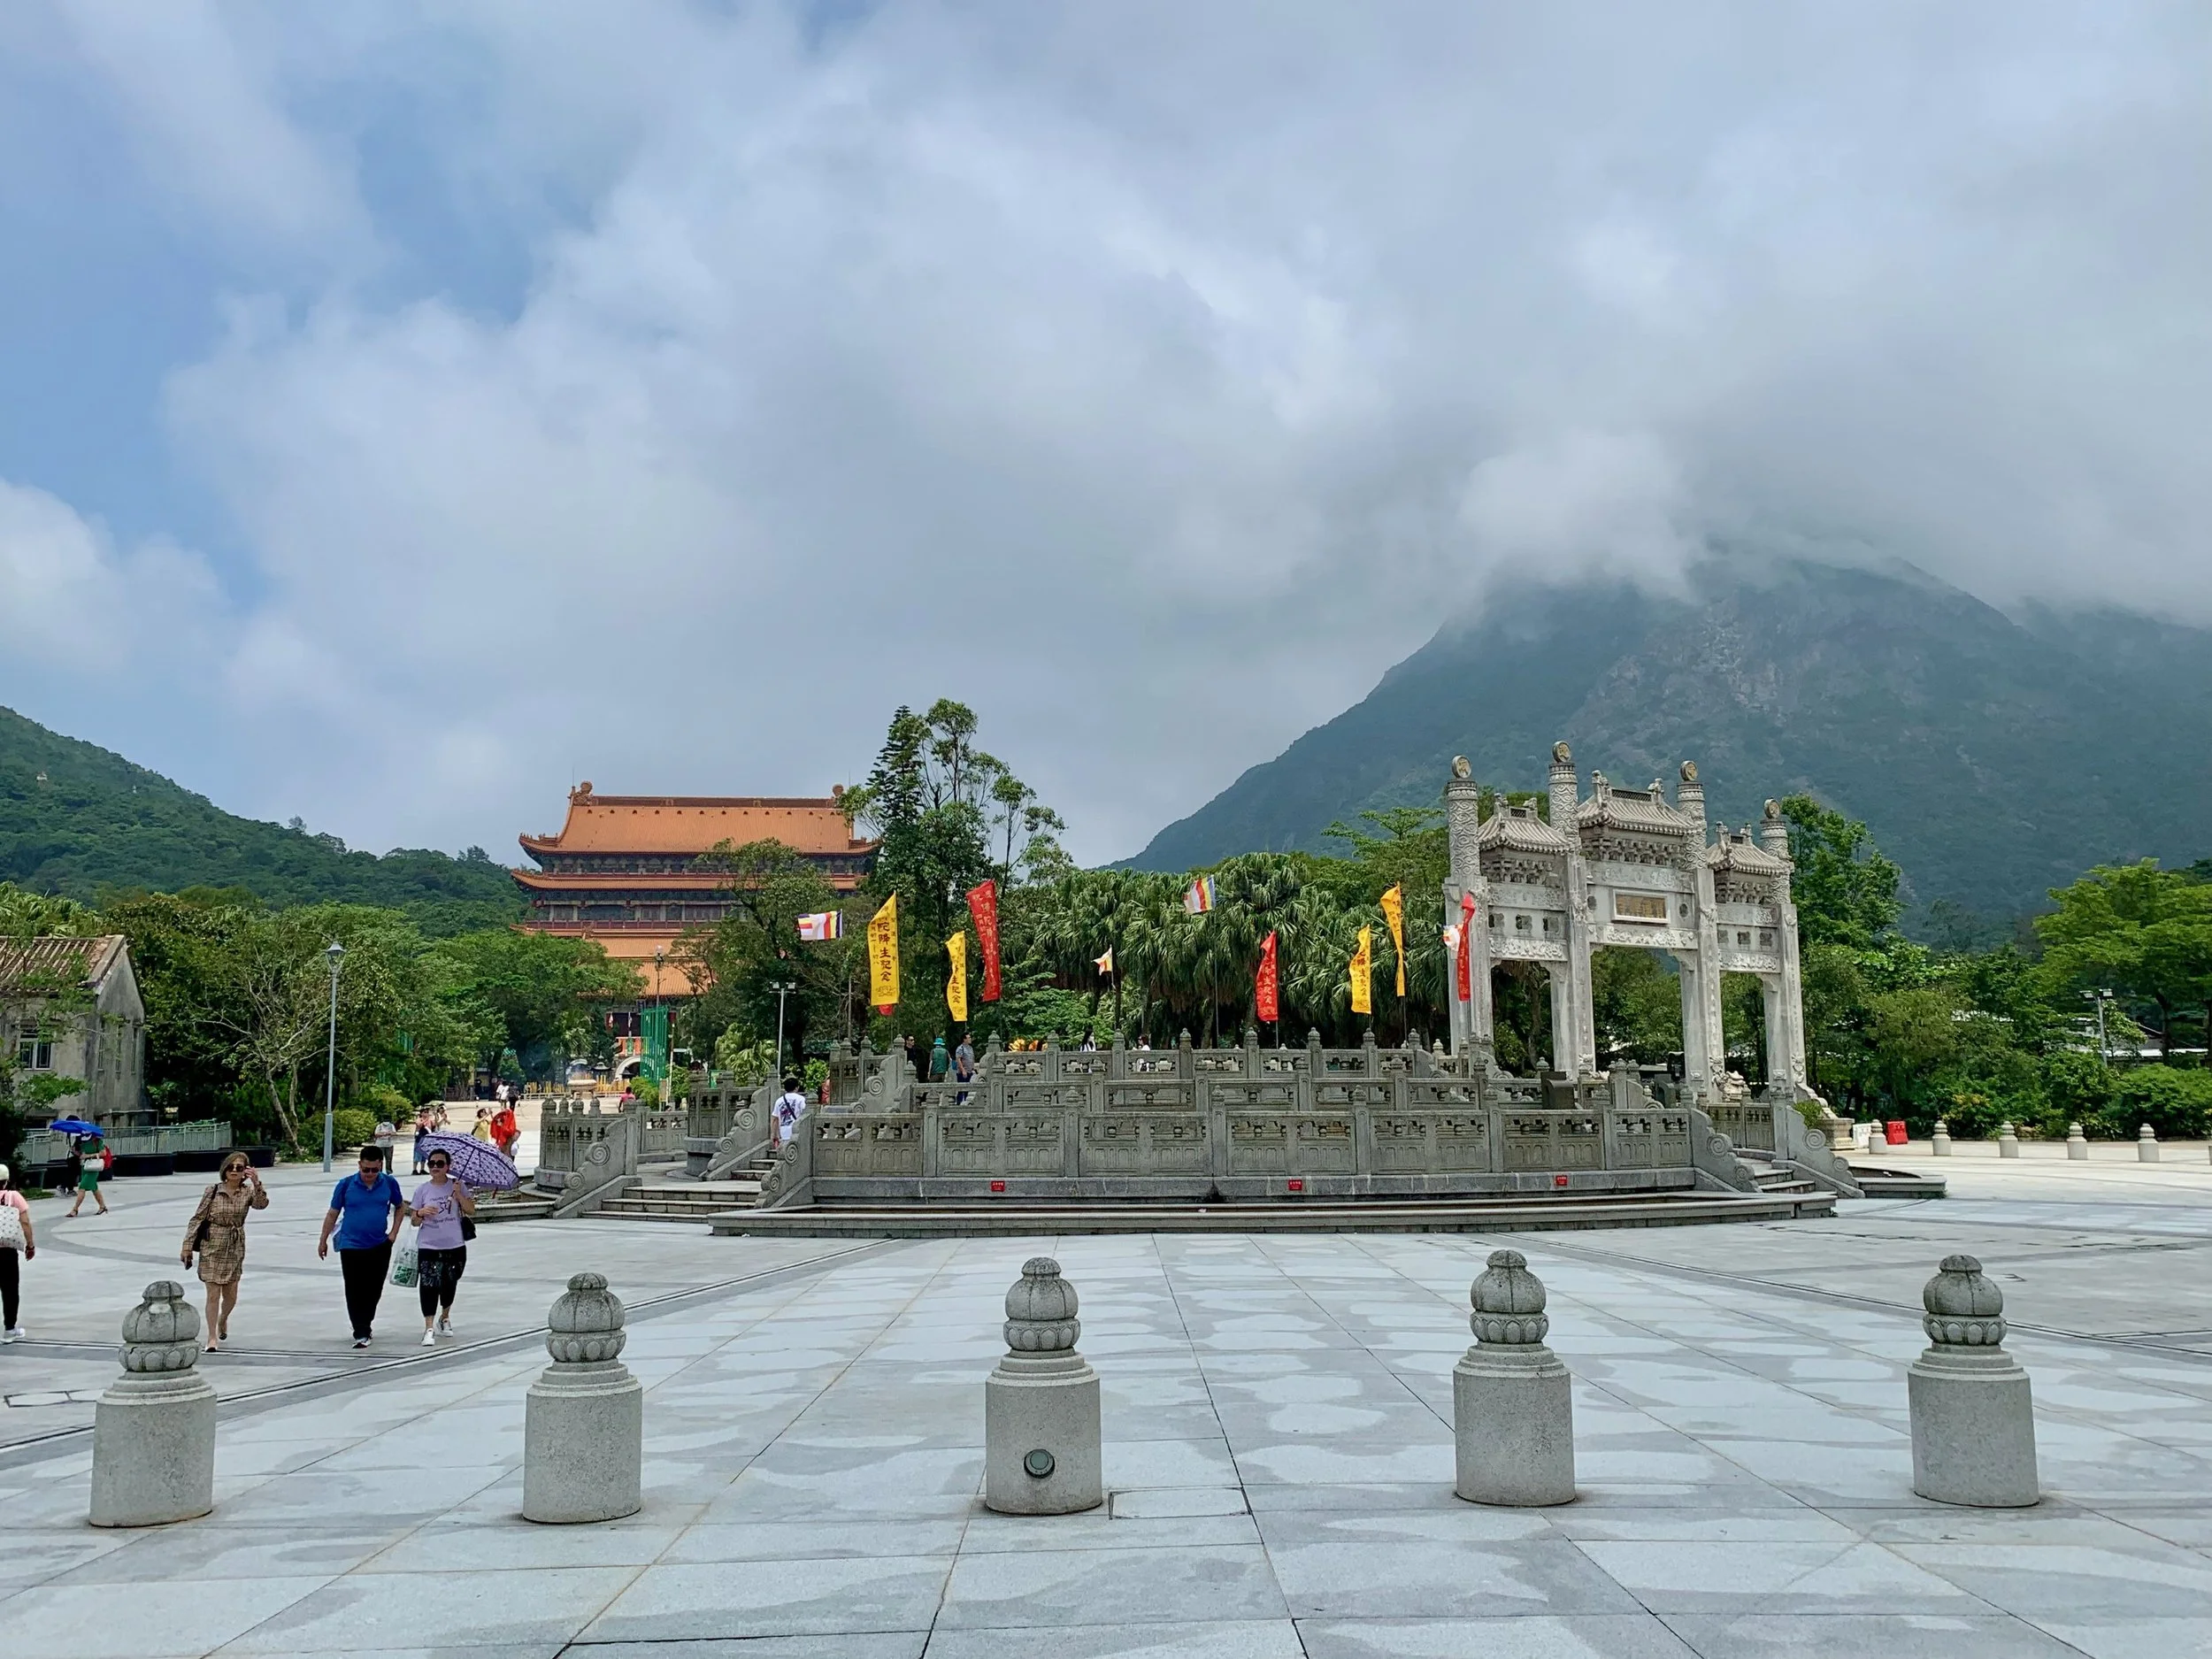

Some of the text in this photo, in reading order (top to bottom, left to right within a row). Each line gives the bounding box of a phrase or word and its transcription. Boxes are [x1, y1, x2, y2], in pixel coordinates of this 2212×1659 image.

[877, 918, 892, 982] 陀降生紀念
